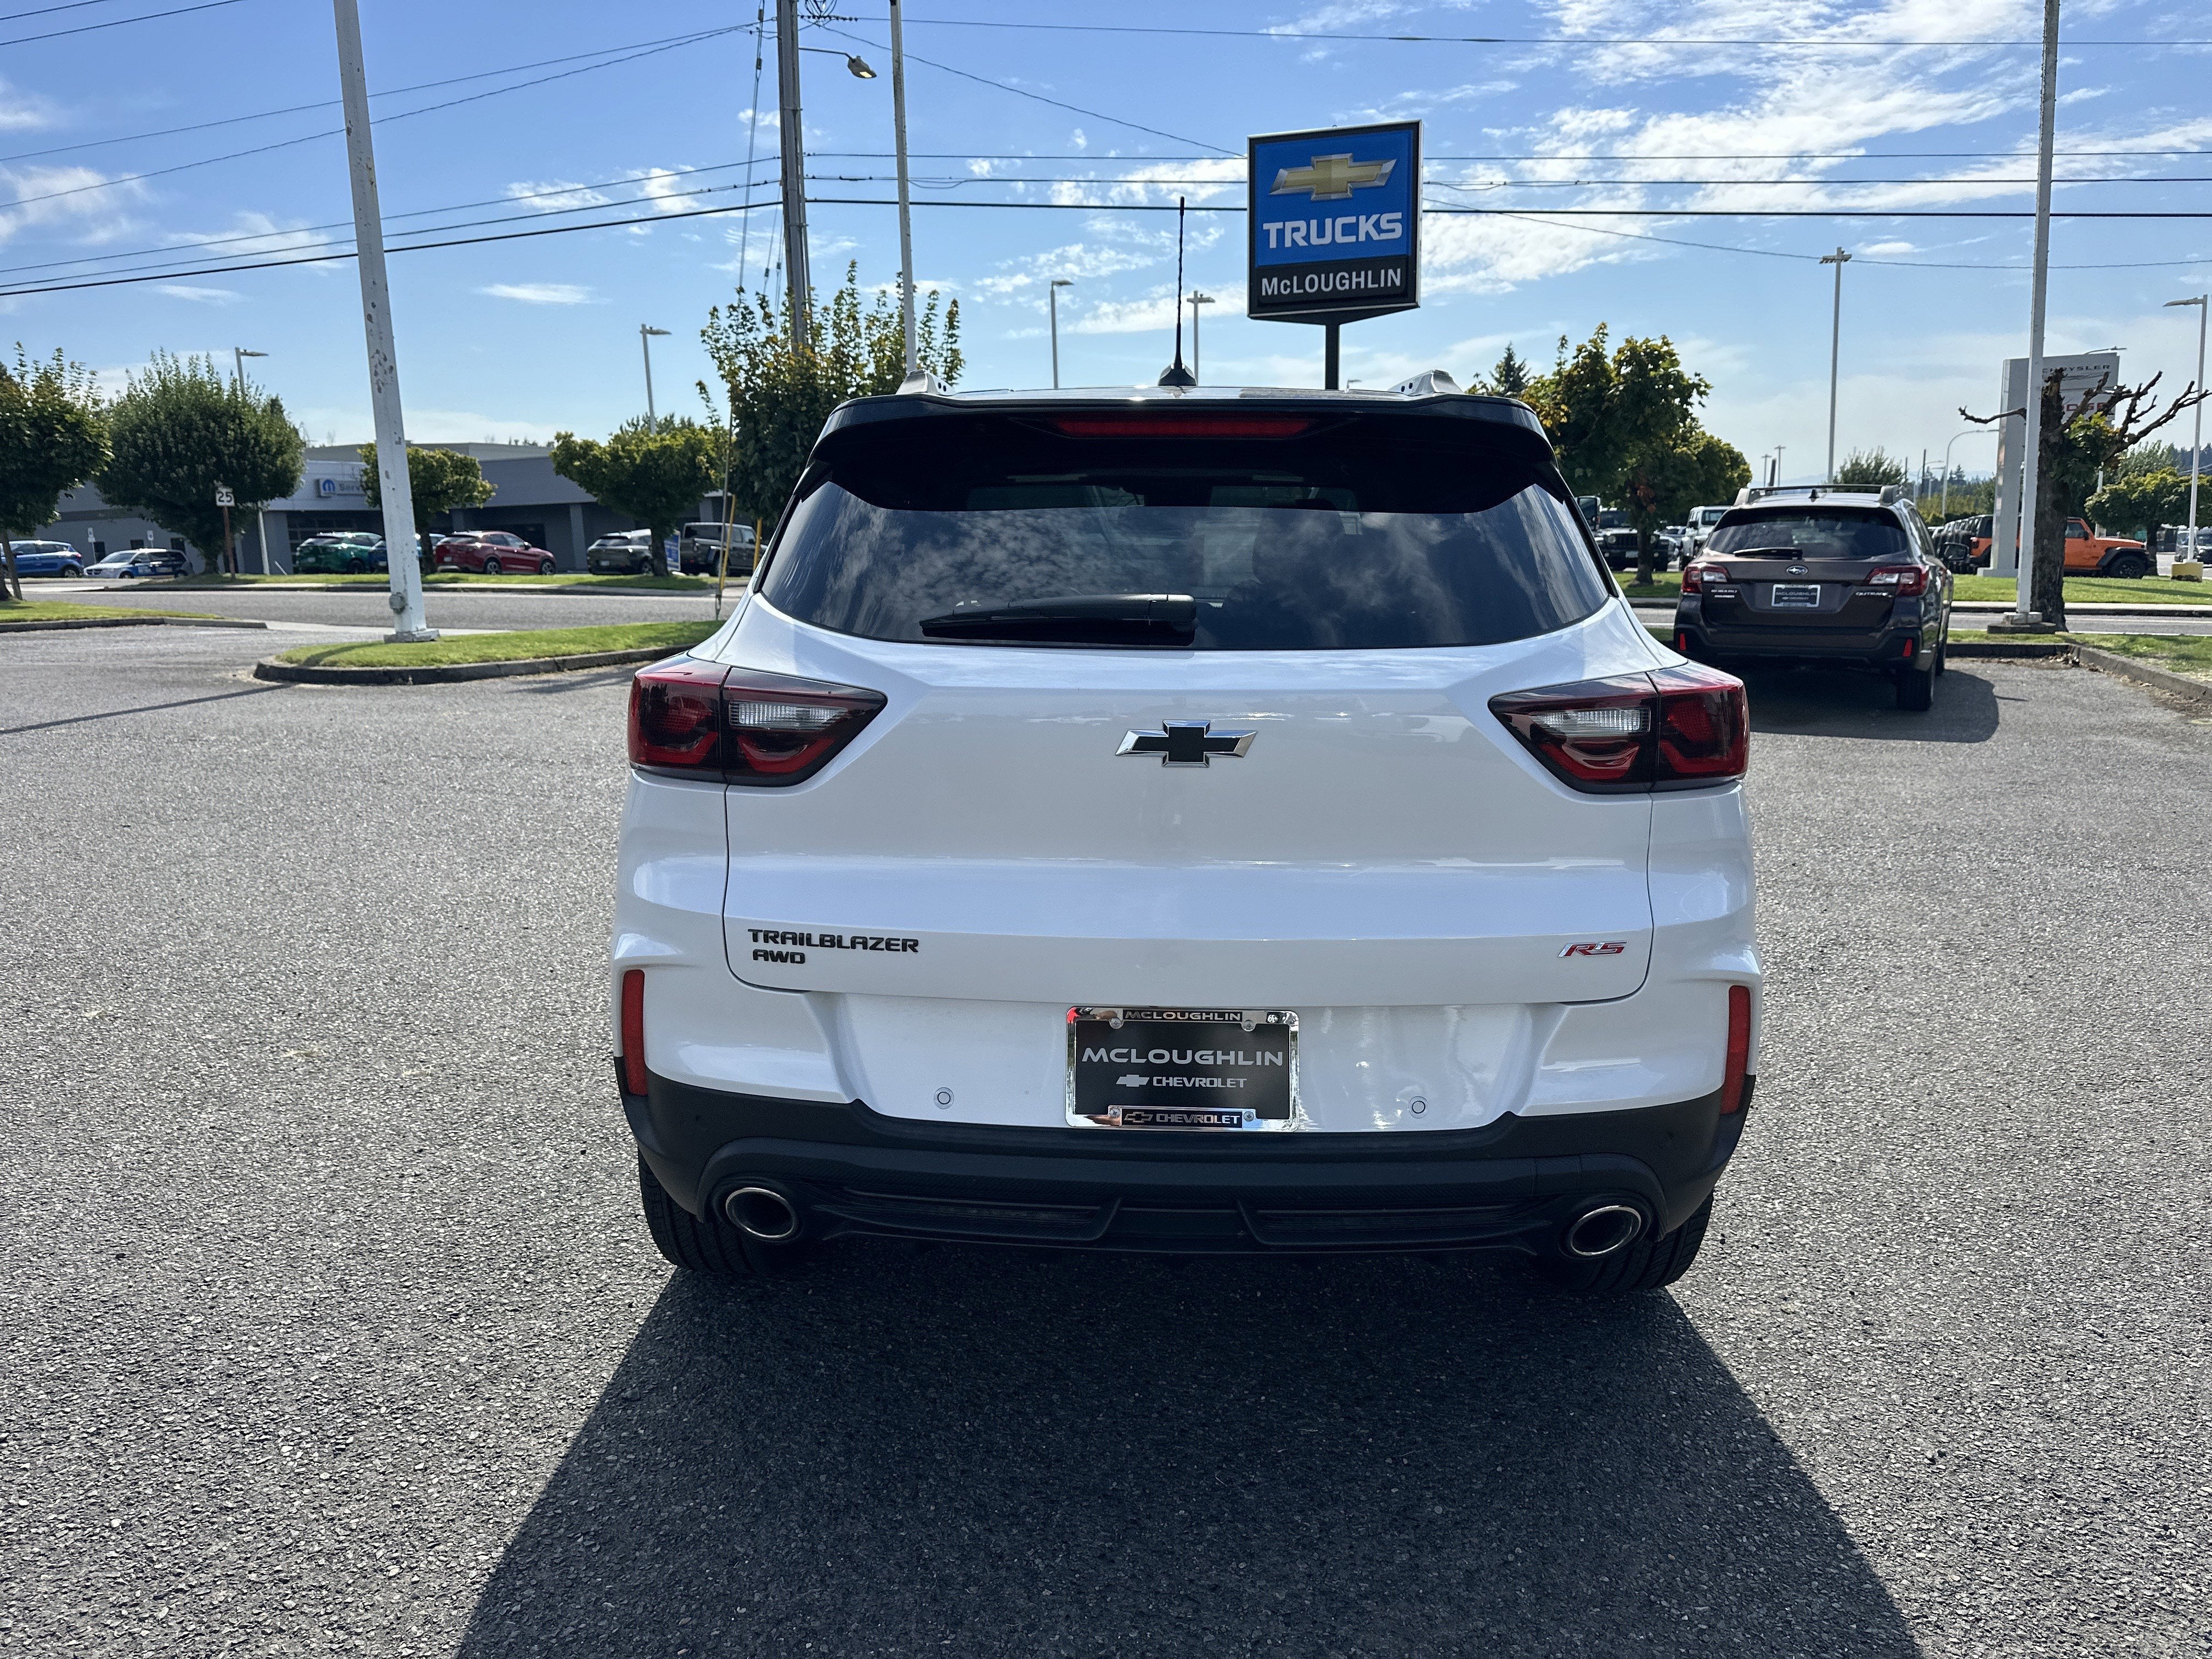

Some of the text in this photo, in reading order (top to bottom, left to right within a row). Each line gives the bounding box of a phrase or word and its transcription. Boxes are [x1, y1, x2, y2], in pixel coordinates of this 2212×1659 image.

[1263, 212, 1402, 249] TRUCKS
[1262, 268, 1401, 296] McLOUGHLIN
[217, 492, 233, 503] 25
[747, 928, 919, 953] TRAILBLAZER
[752, 949, 805, 964] AWD
[1557, 940, 1628, 958] RS
[1125, 1011, 1241, 1021] MCLOUGHLIN
[1081, 1047, 1284, 1066] MCLOUGHLIN
[1153, 1076, 1247, 1088] CHEVROLET
[1156, 1114, 1240, 1124] CHEVROLET
